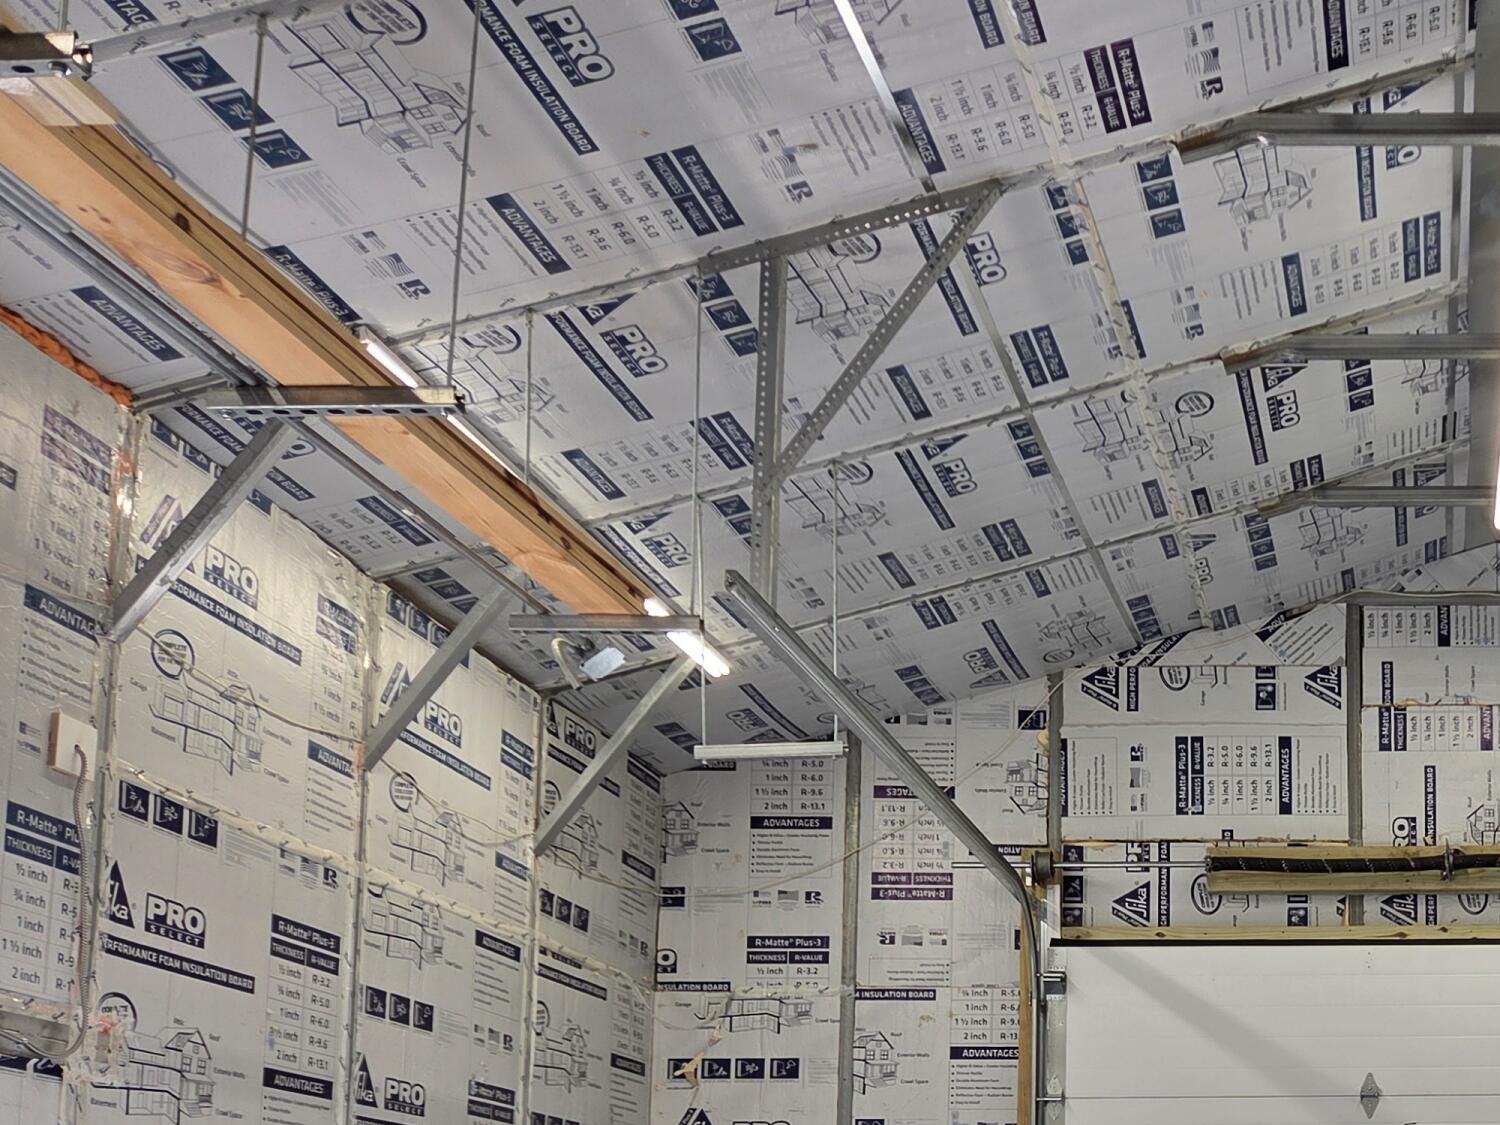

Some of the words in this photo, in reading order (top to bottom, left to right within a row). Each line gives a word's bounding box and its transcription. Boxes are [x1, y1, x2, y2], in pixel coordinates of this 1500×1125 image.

[532, 22, 582, 82] SELECT
[542, 6, 615, 81] PRO
[525, 67, 565, 123] INSULATION
[563, 120, 591, 152] BOARD
[504, 208, 556, 263] ADVANTAGES
[611, 324, 669, 375] PRO
[1280, 389, 1301, 429] PRO
[944, 458, 978, 494] PRO
[656, 530, 692, 567] PRO
[205, 545, 258, 596] PRO
[424, 701, 462, 736] PRO
[1207, 746, 1216, 768] R-3.2
[1264, 743, 1273, 767] R-13.1
[772, 773, 789, 782] inch
[801, 774, 824, 782] R-6.0
[1280, 748, 1291, 804] ADVANTAGES
[771, 802, 788, 810] inch
[801, 802, 825, 811] R-13.1
[762, 818, 820, 828] ADVANTAGES
[6, 835, 53, 859] THICKNESS
[145, 894, 205, 936] PRO
[149, 923, 202, 947] SELECT
[796, 937, 822, 948] Plus-3
[749, 953, 786, 962] THICKNESS
[794, 953, 823, 962] R-VALUE
[229, 973, 254, 991] BOARD
[797, 967, 819, 976] R-3.2
[859, 991, 909, 999] INSULATION
[910, 990, 935, 999] BOARD
[385, 1079, 425, 1105] PRO
